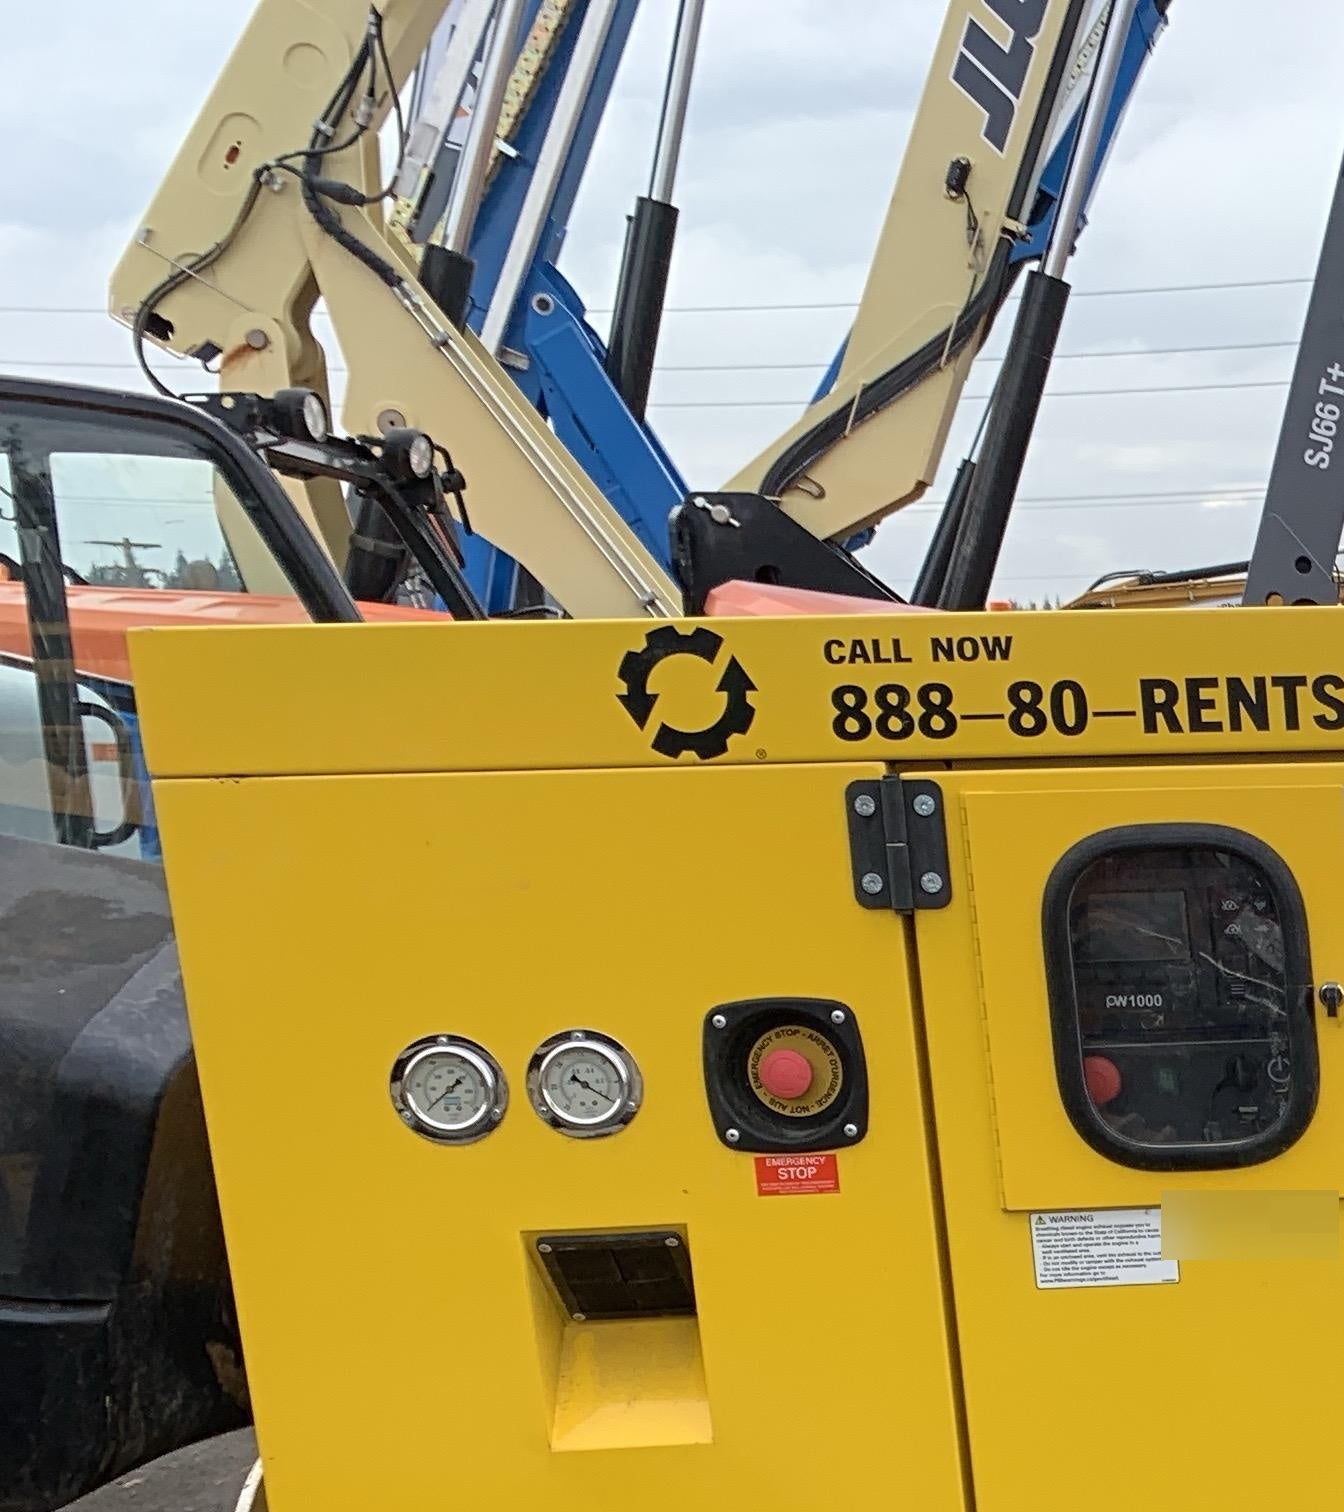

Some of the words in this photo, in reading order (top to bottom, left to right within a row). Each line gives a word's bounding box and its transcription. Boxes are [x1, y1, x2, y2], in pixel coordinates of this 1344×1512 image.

[1318, 362, 1344, 396] T+
[1303, 401, 1340, 470] SJ66
[823, 638, 912, 664] CALL
[931, 635, 1014, 663] NOW
[775, 1029, 800, 1039] STOP
[766, 1157, 826, 1166] EMERGENCY
[778, 1167, 816, 1180] STOP
[1048, 1215, 1094, 1223] WARNING
